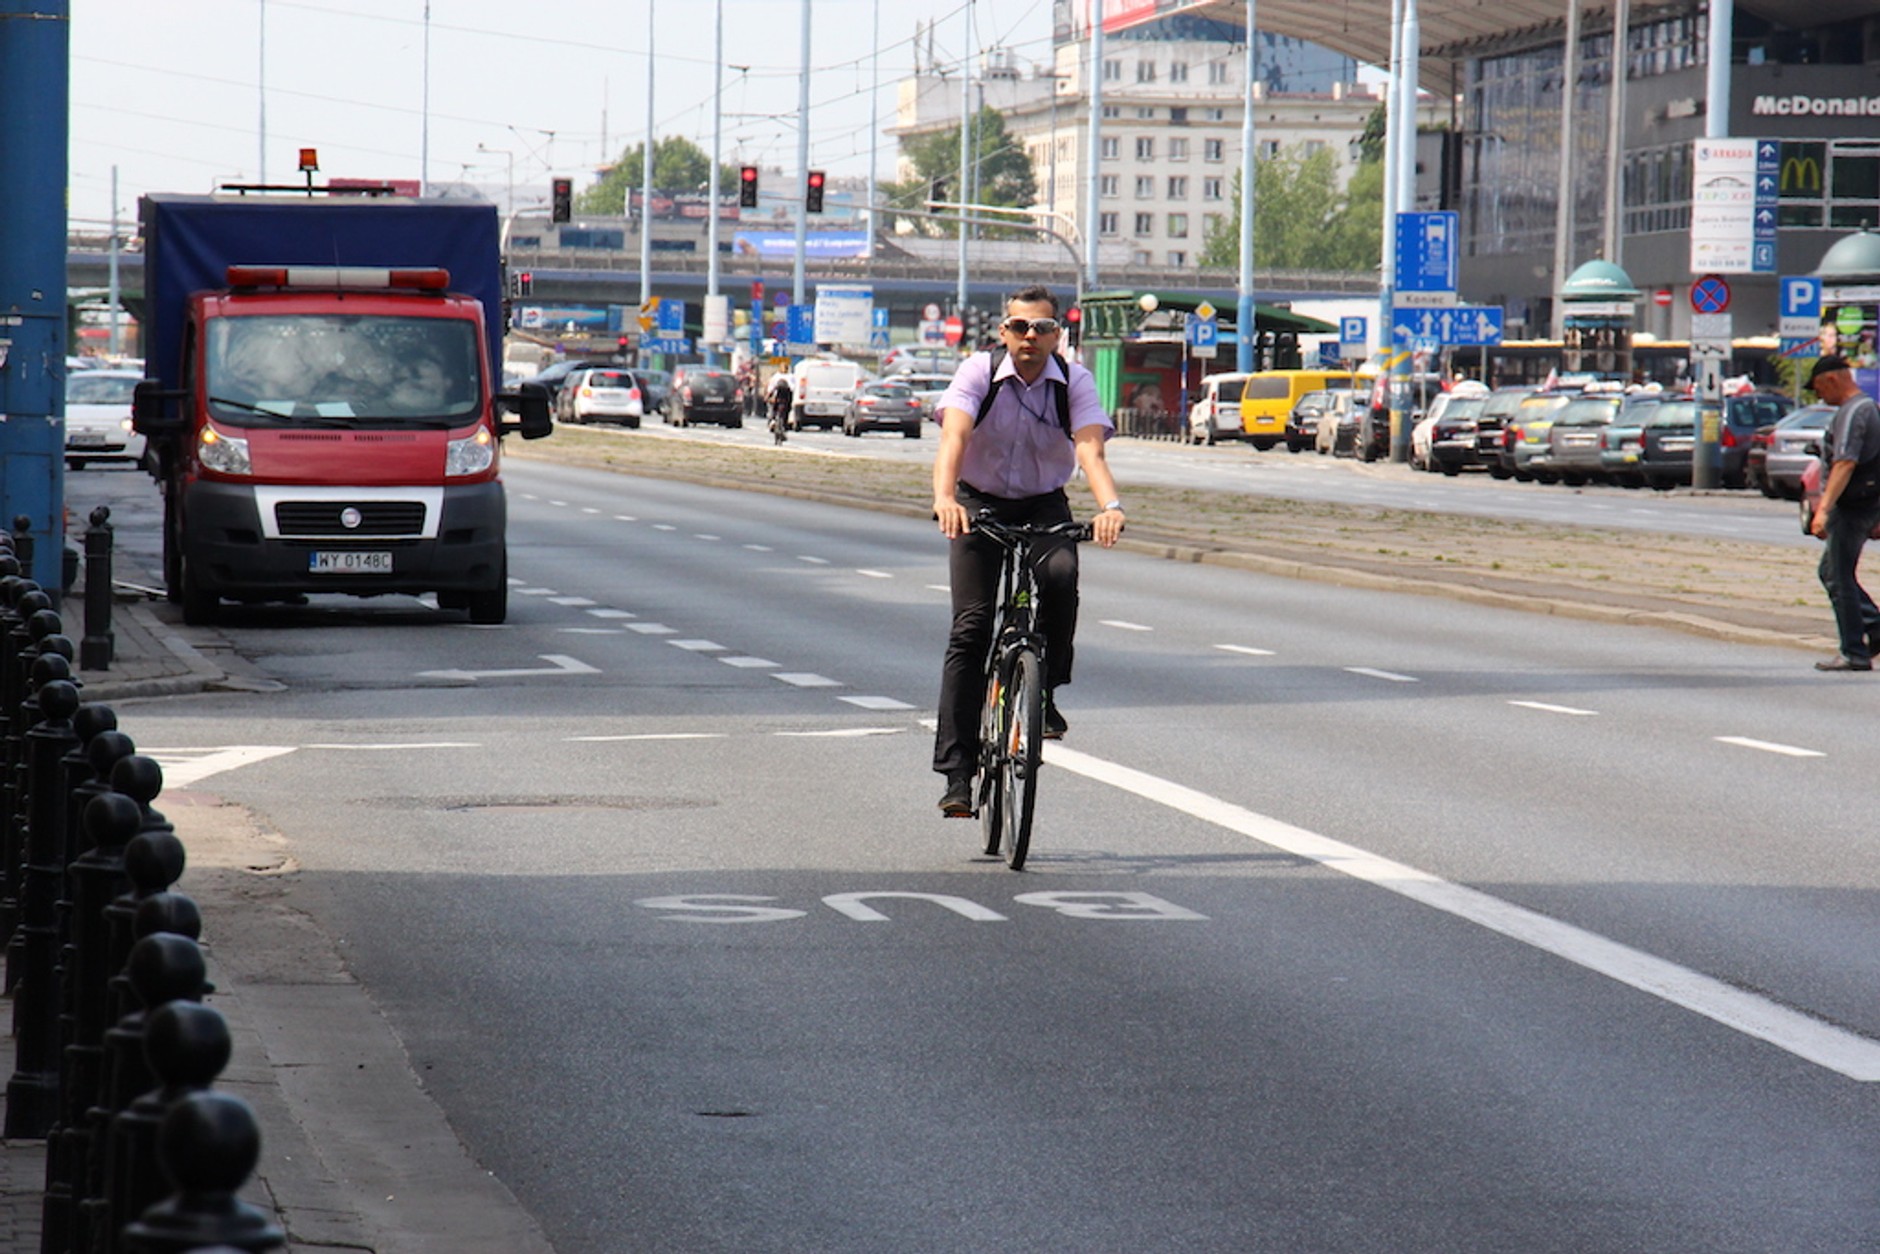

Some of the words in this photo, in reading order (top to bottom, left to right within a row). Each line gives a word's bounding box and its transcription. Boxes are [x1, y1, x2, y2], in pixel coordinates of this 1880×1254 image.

[1753, 95, 1880, 115] McDonald
[1697, 191, 1728, 201] EXPO
[1405, 294, 1446, 303] Koniec
[1788, 281, 1814, 313] P
[1197, 324, 1213, 343] P
[1345, 319, 1363, 340] P
[319, 554, 339, 568] WY
